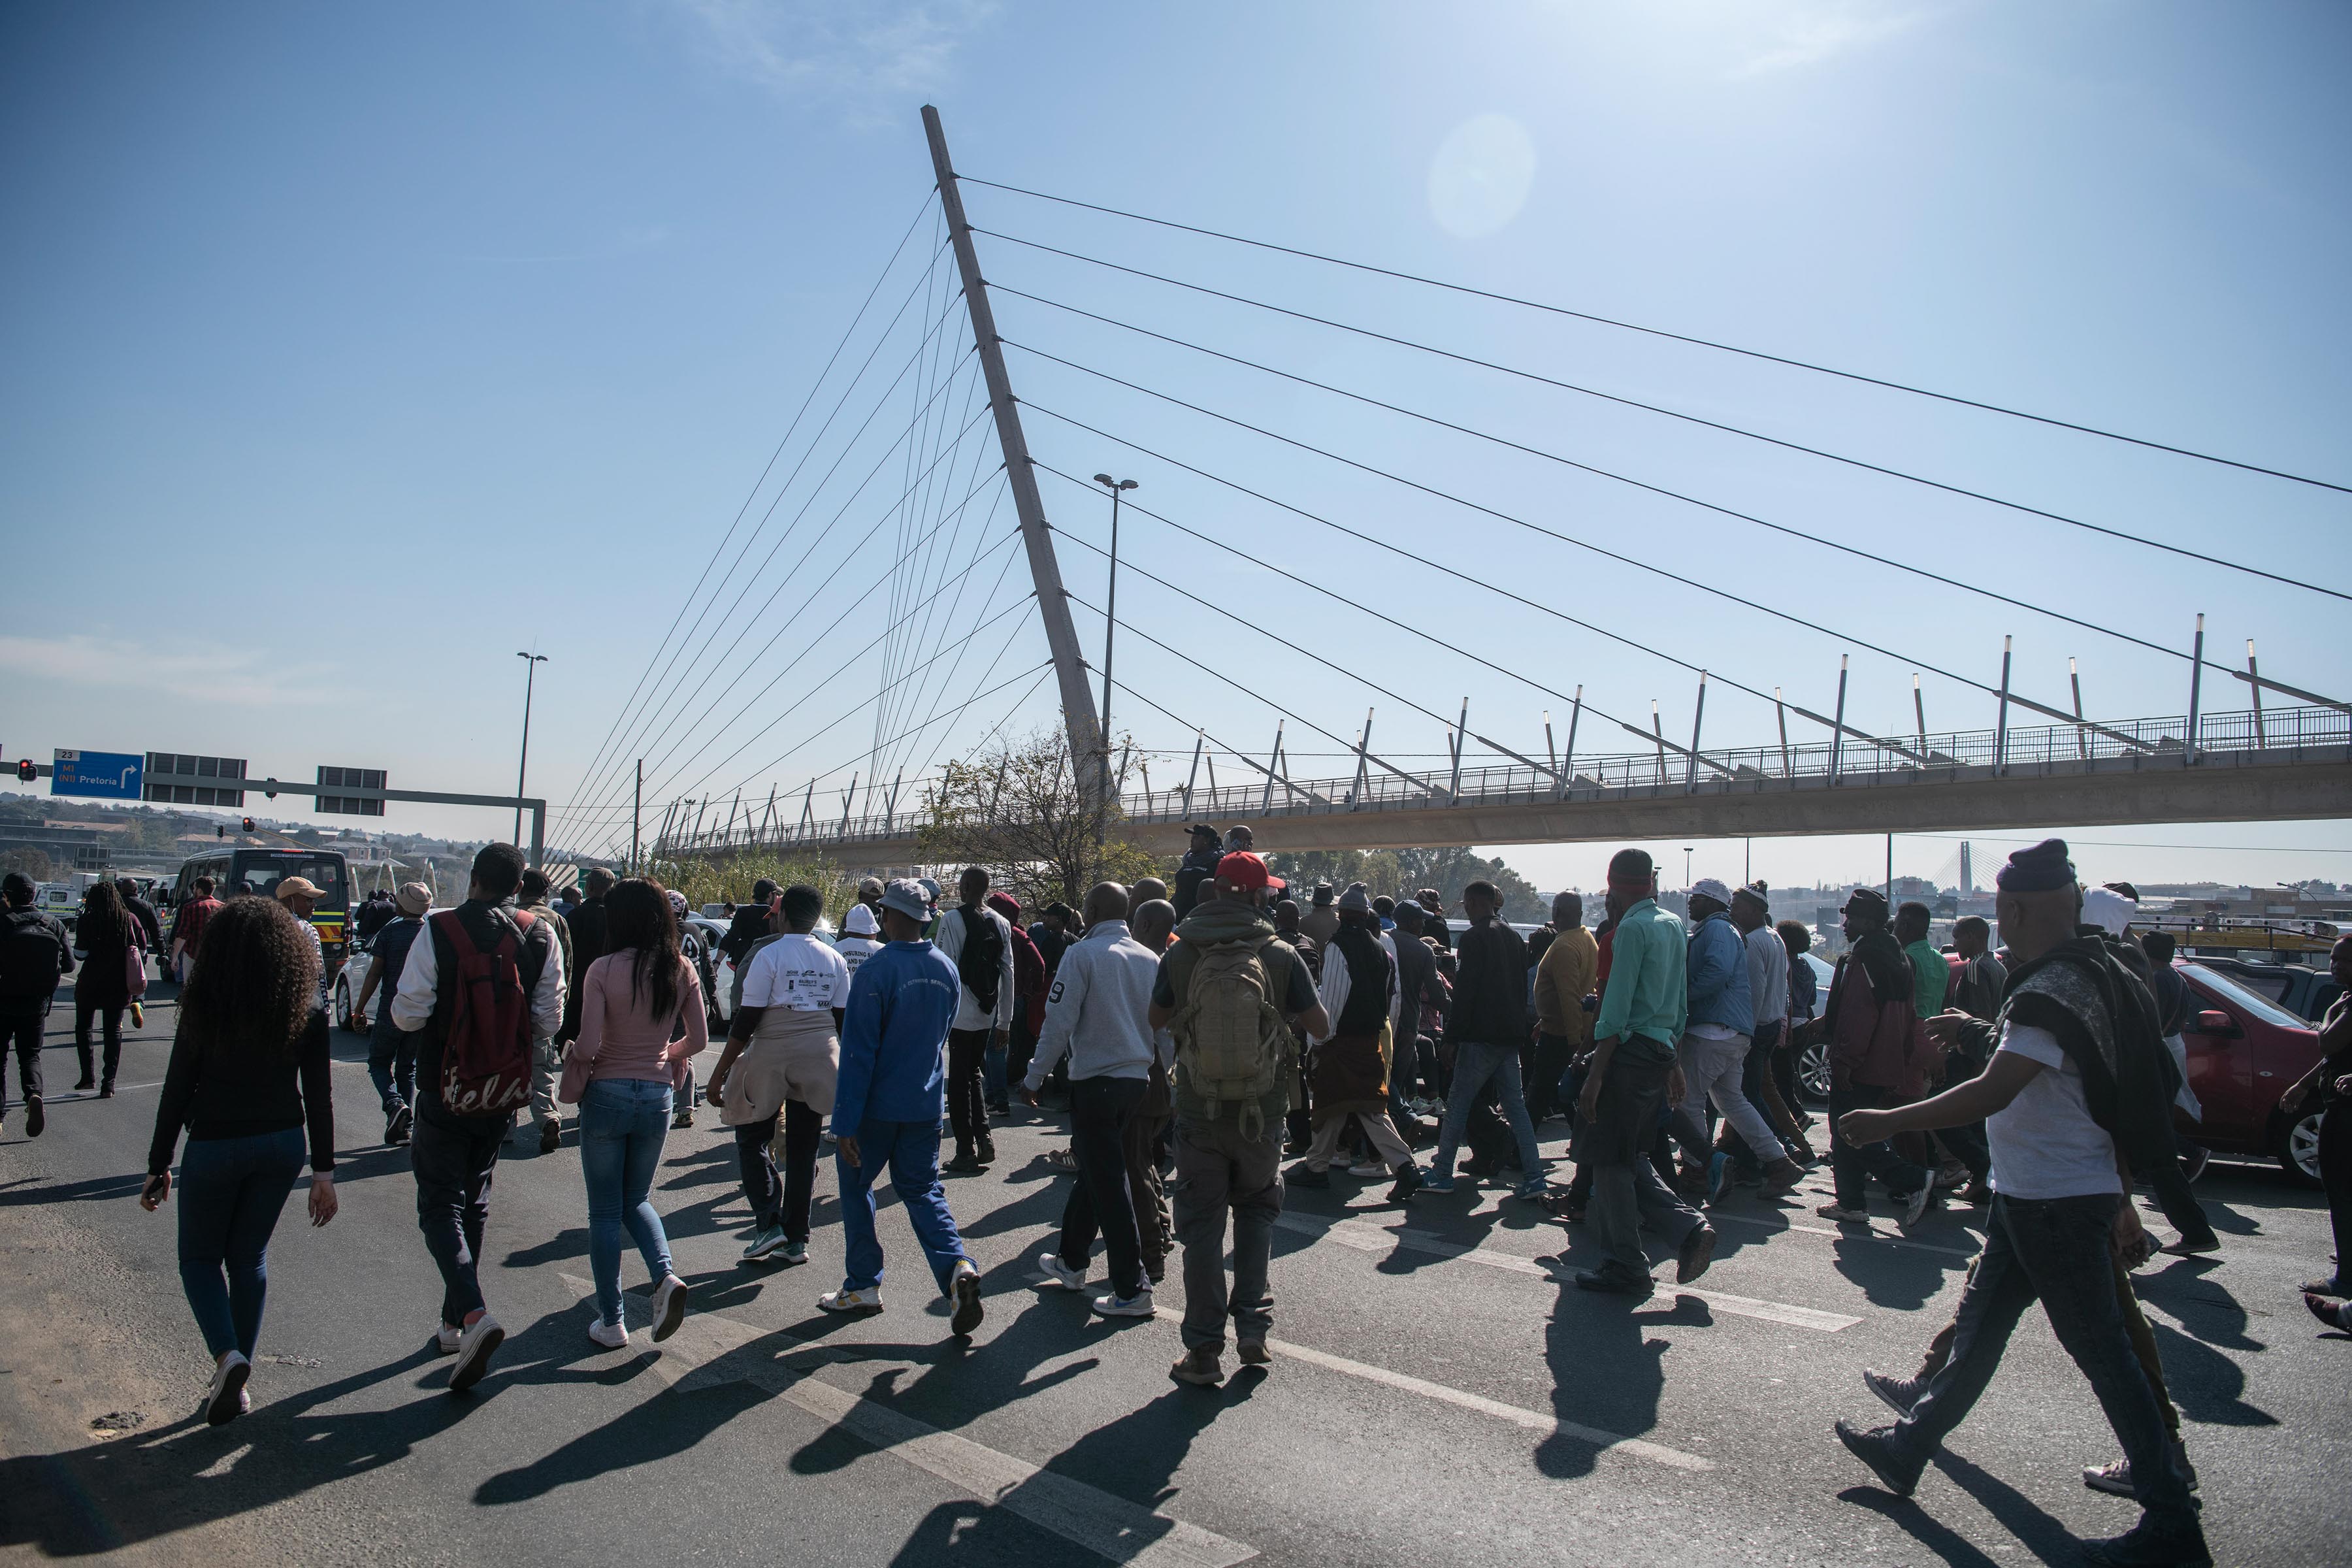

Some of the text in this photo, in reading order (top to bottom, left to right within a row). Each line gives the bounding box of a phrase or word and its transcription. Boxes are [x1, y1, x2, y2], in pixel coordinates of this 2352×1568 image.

[59, 774, 117, 785] (N1) Pretoria
[1048, 980, 1066, 1004] 9
